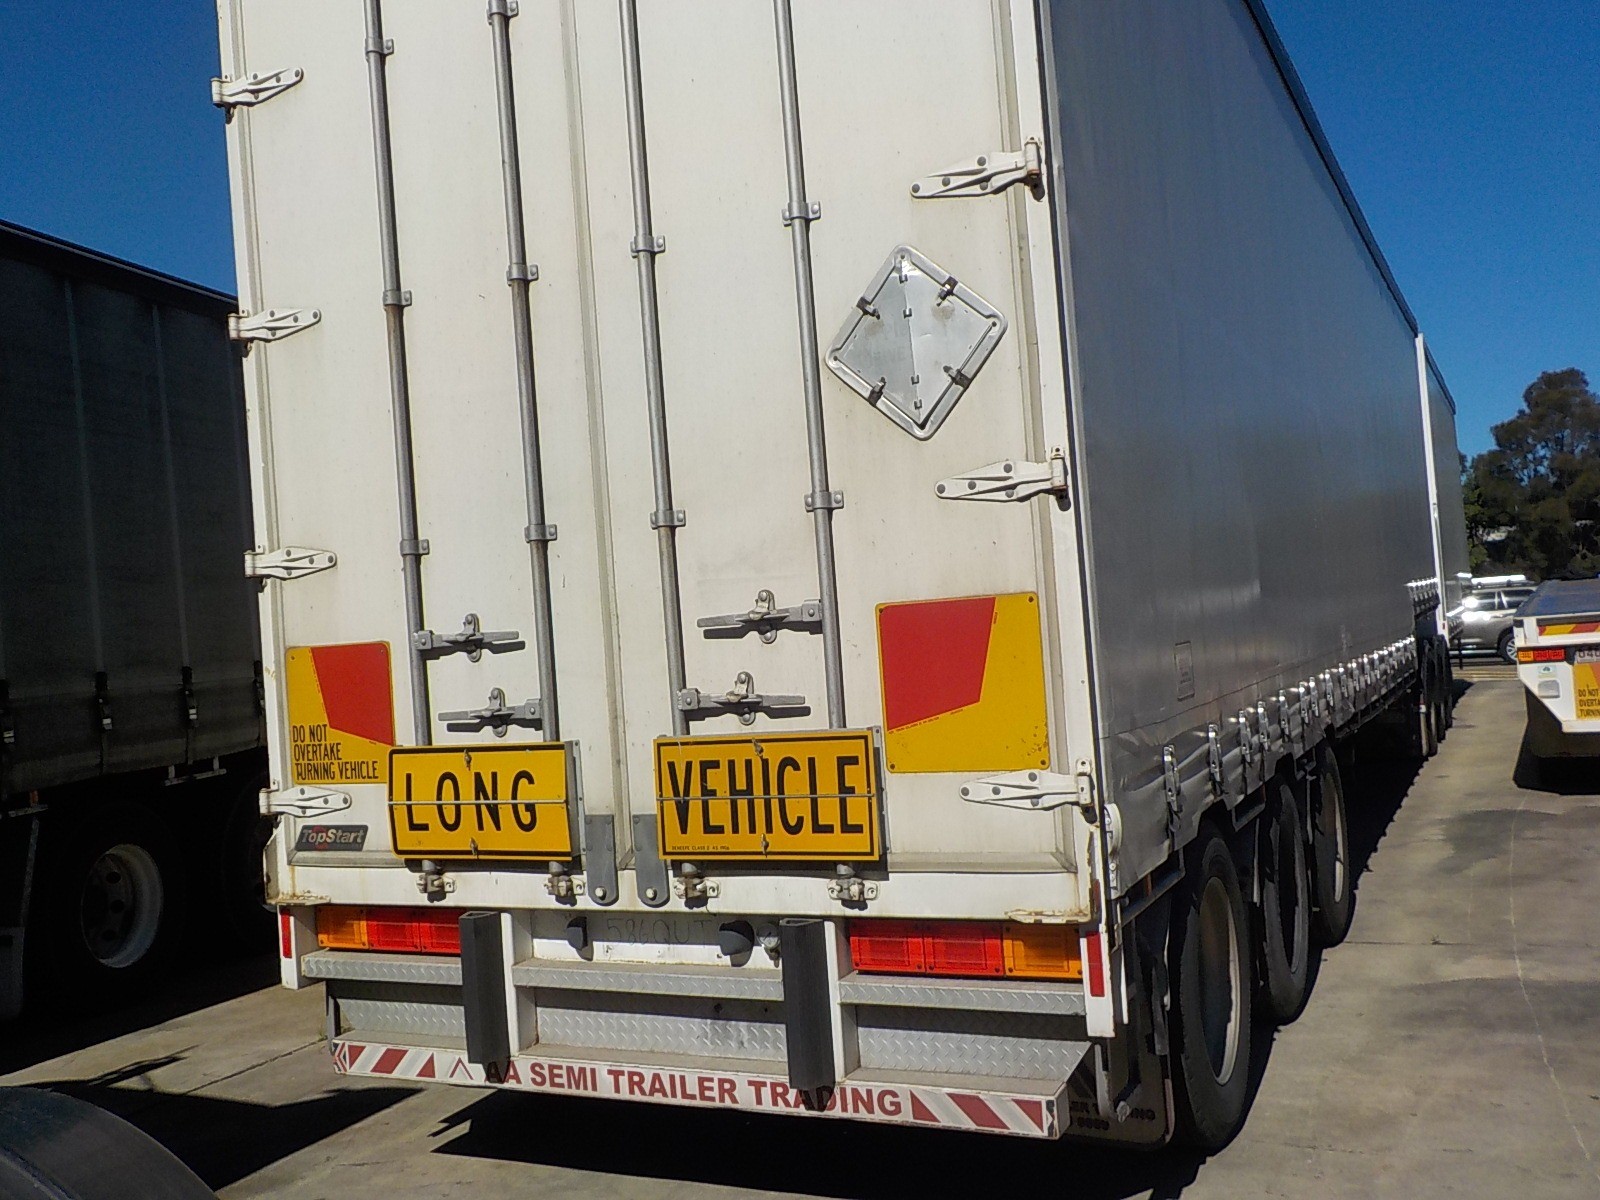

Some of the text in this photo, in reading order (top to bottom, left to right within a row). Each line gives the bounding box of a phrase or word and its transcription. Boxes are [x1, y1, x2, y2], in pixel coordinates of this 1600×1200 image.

[1578, 689, 1586, 697] DO
[292, 724, 328, 743] DO NOT
[294, 743, 342, 762] OVERTAKE
[295, 760, 379, 780] TURNING VEHICLE
[405, 769, 538, 832] LONG
[666, 756, 864, 835] VEHICLE
[301, 828, 365, 845] TopStart
[529, 1062, 598, 1092] SEMI
[607, 1069, 739, 1104] TRAILER
[747, 1079, 902, 1116] TRADING
